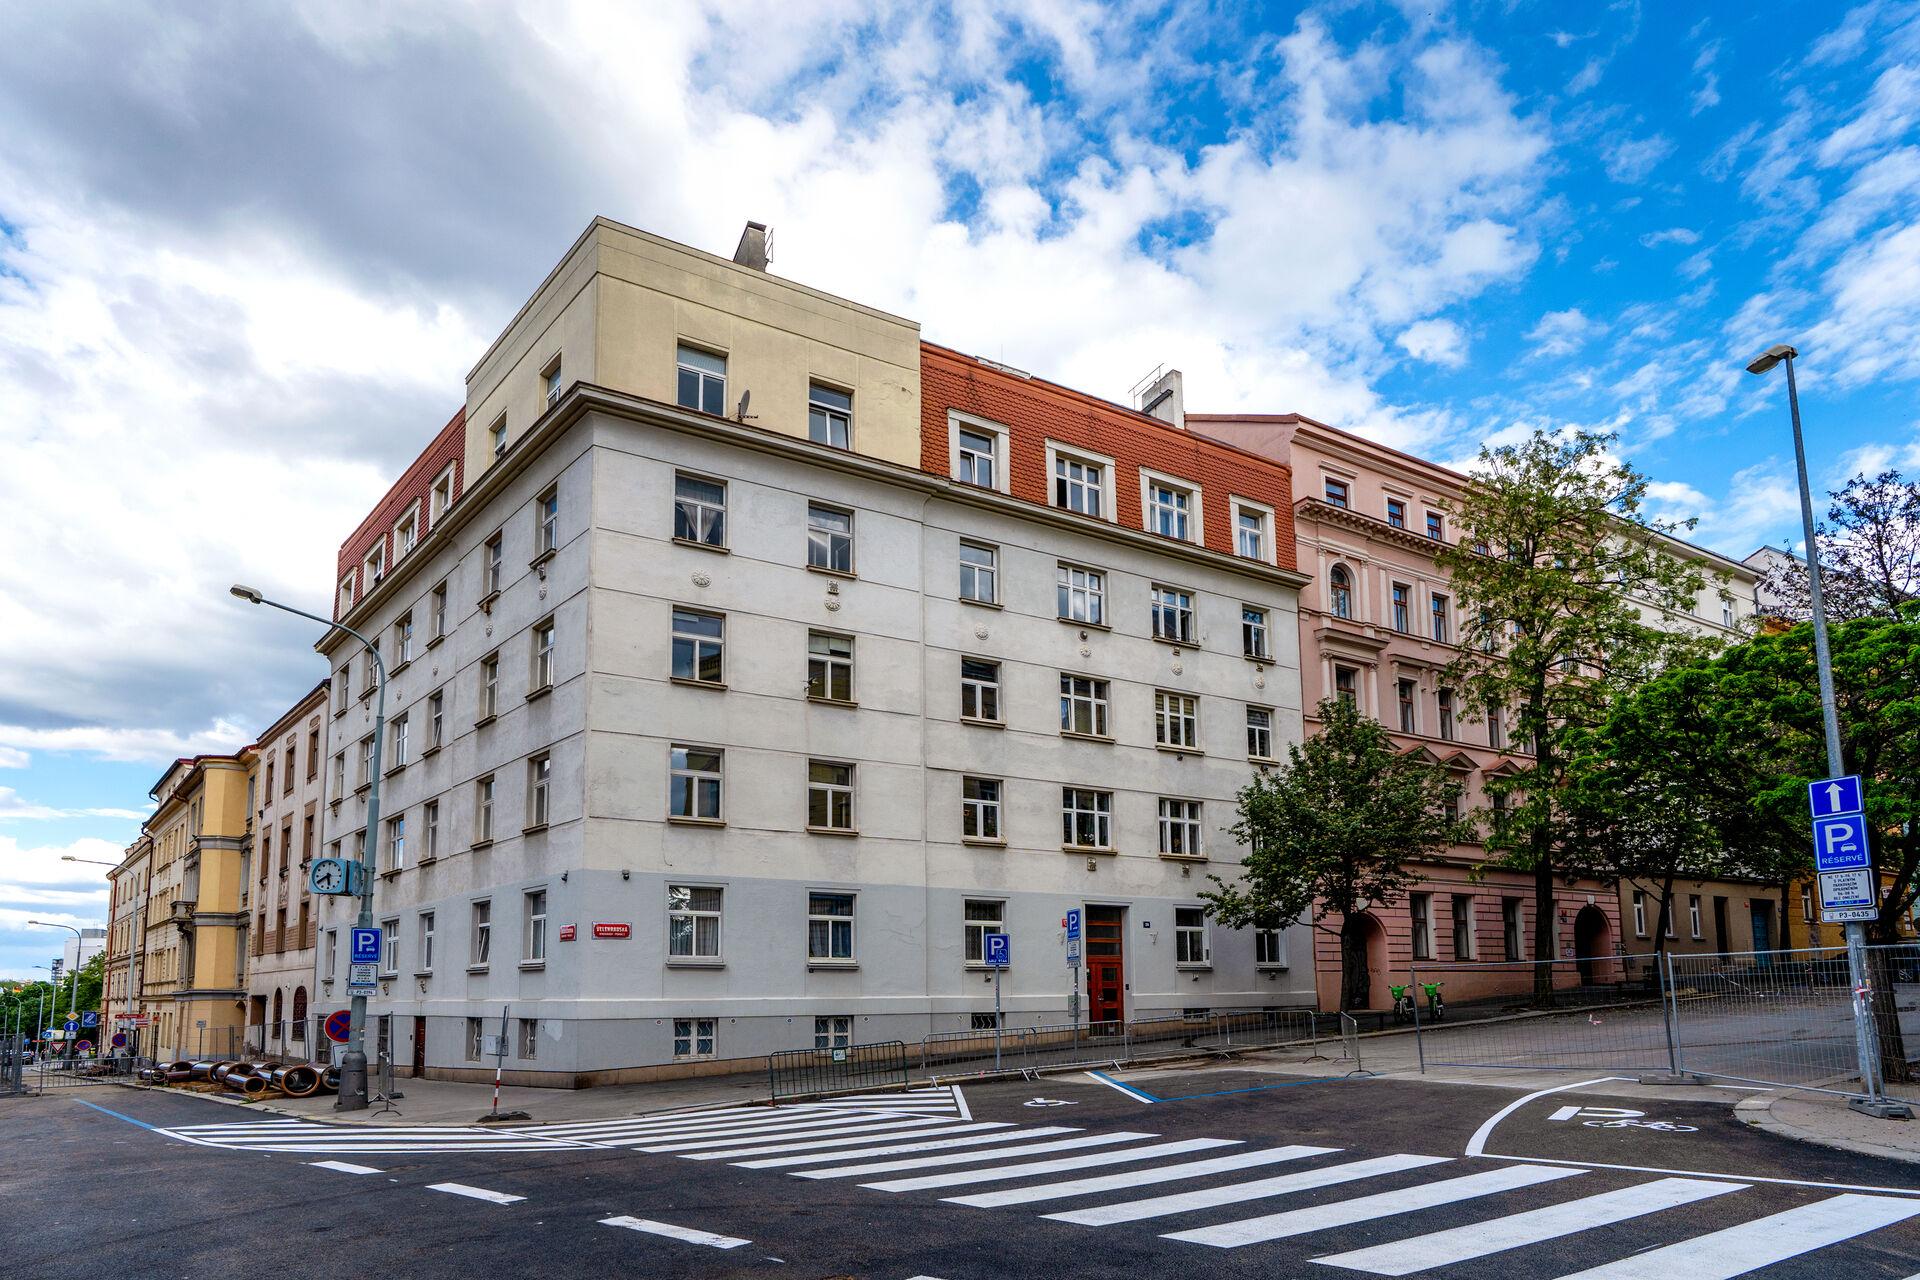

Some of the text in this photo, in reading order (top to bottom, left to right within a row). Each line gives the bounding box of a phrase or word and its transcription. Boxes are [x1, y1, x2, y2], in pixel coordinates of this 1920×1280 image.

[1825, 824, 1853, 854] P
[1822, 853, 1863, 864] RÉSERVÉ
[1069, 913, 1078, 931] P
[1839, 911, 1870, 919] P3-0435
[358, 932, 375, 952] P
[991, 938, 1005, 956] P
